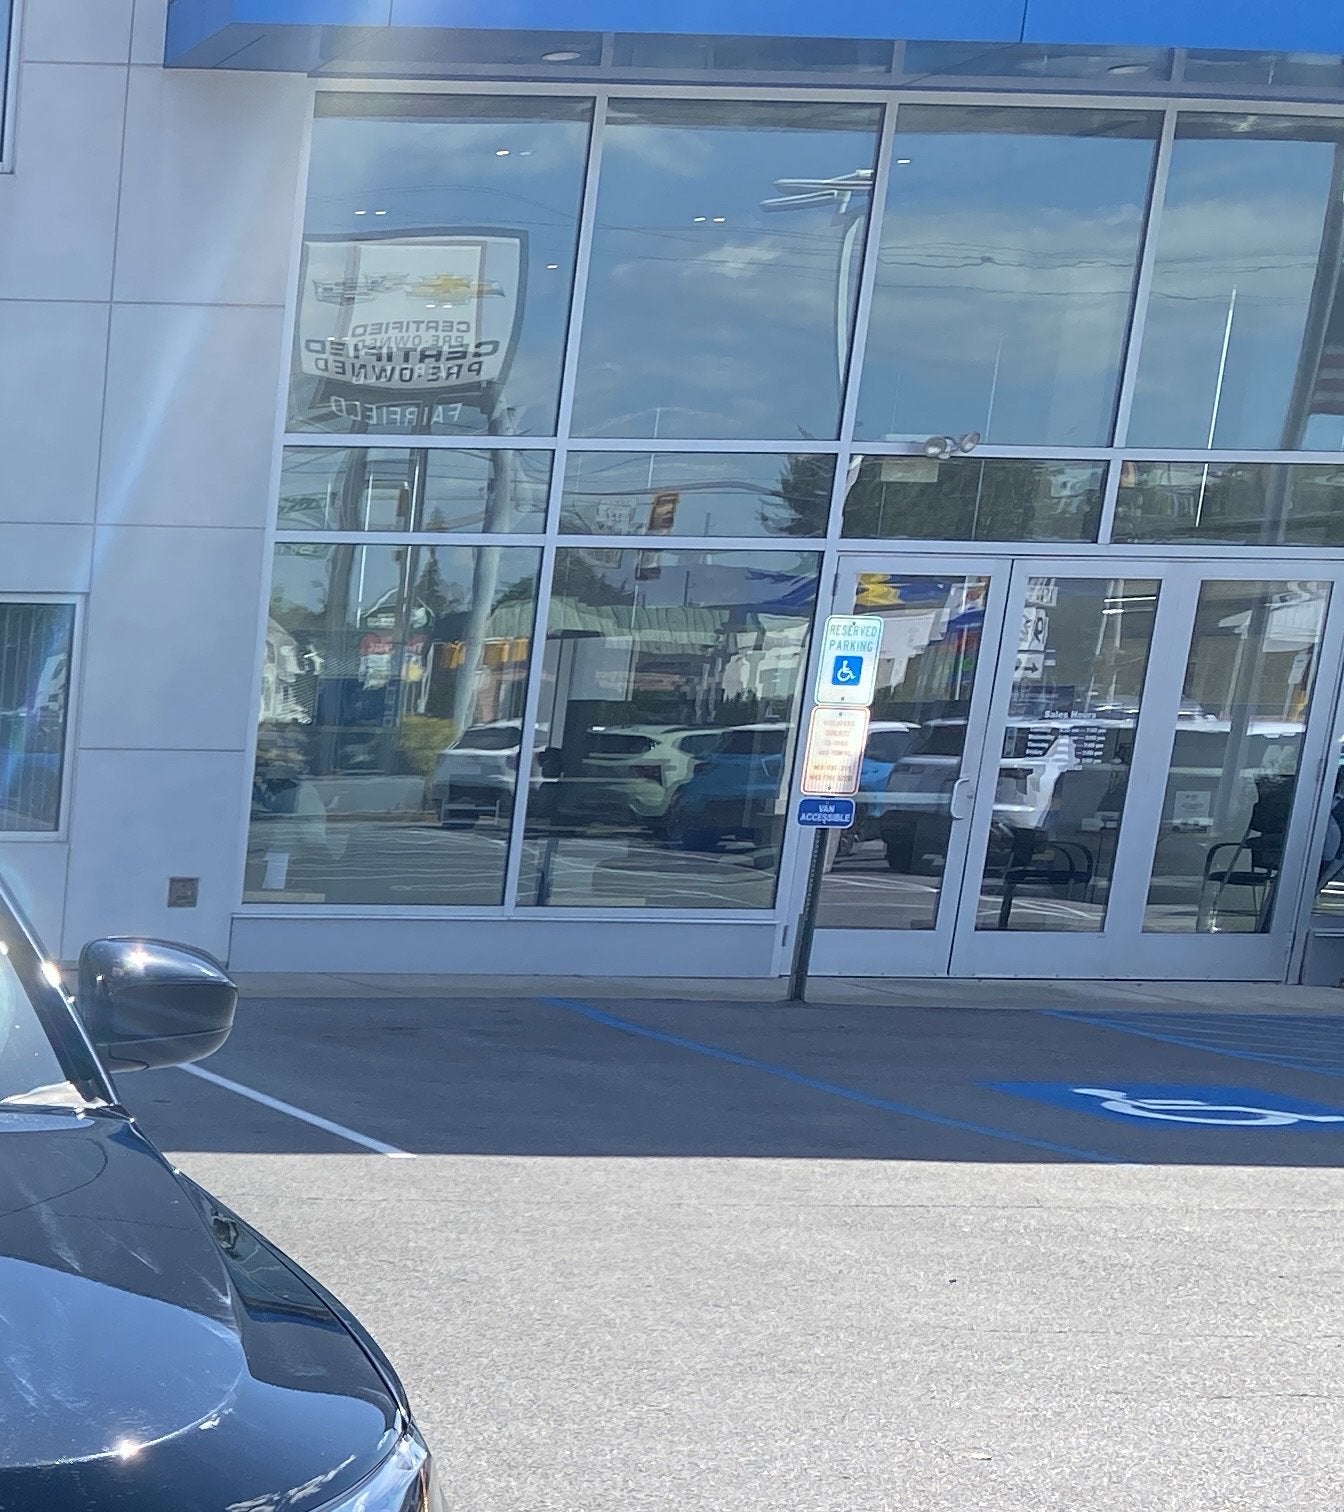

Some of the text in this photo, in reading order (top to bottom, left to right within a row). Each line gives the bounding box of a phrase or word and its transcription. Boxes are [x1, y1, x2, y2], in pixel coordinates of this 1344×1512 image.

[829, 624, 878, 637] RESERVED
[829, 639, 873, 652] PARKING
[1044, 710, 1097, 719] Sales Hours
[818, 804, 835, 813] VAN
[799, 812, 851, 823] ACCESSIBLE
